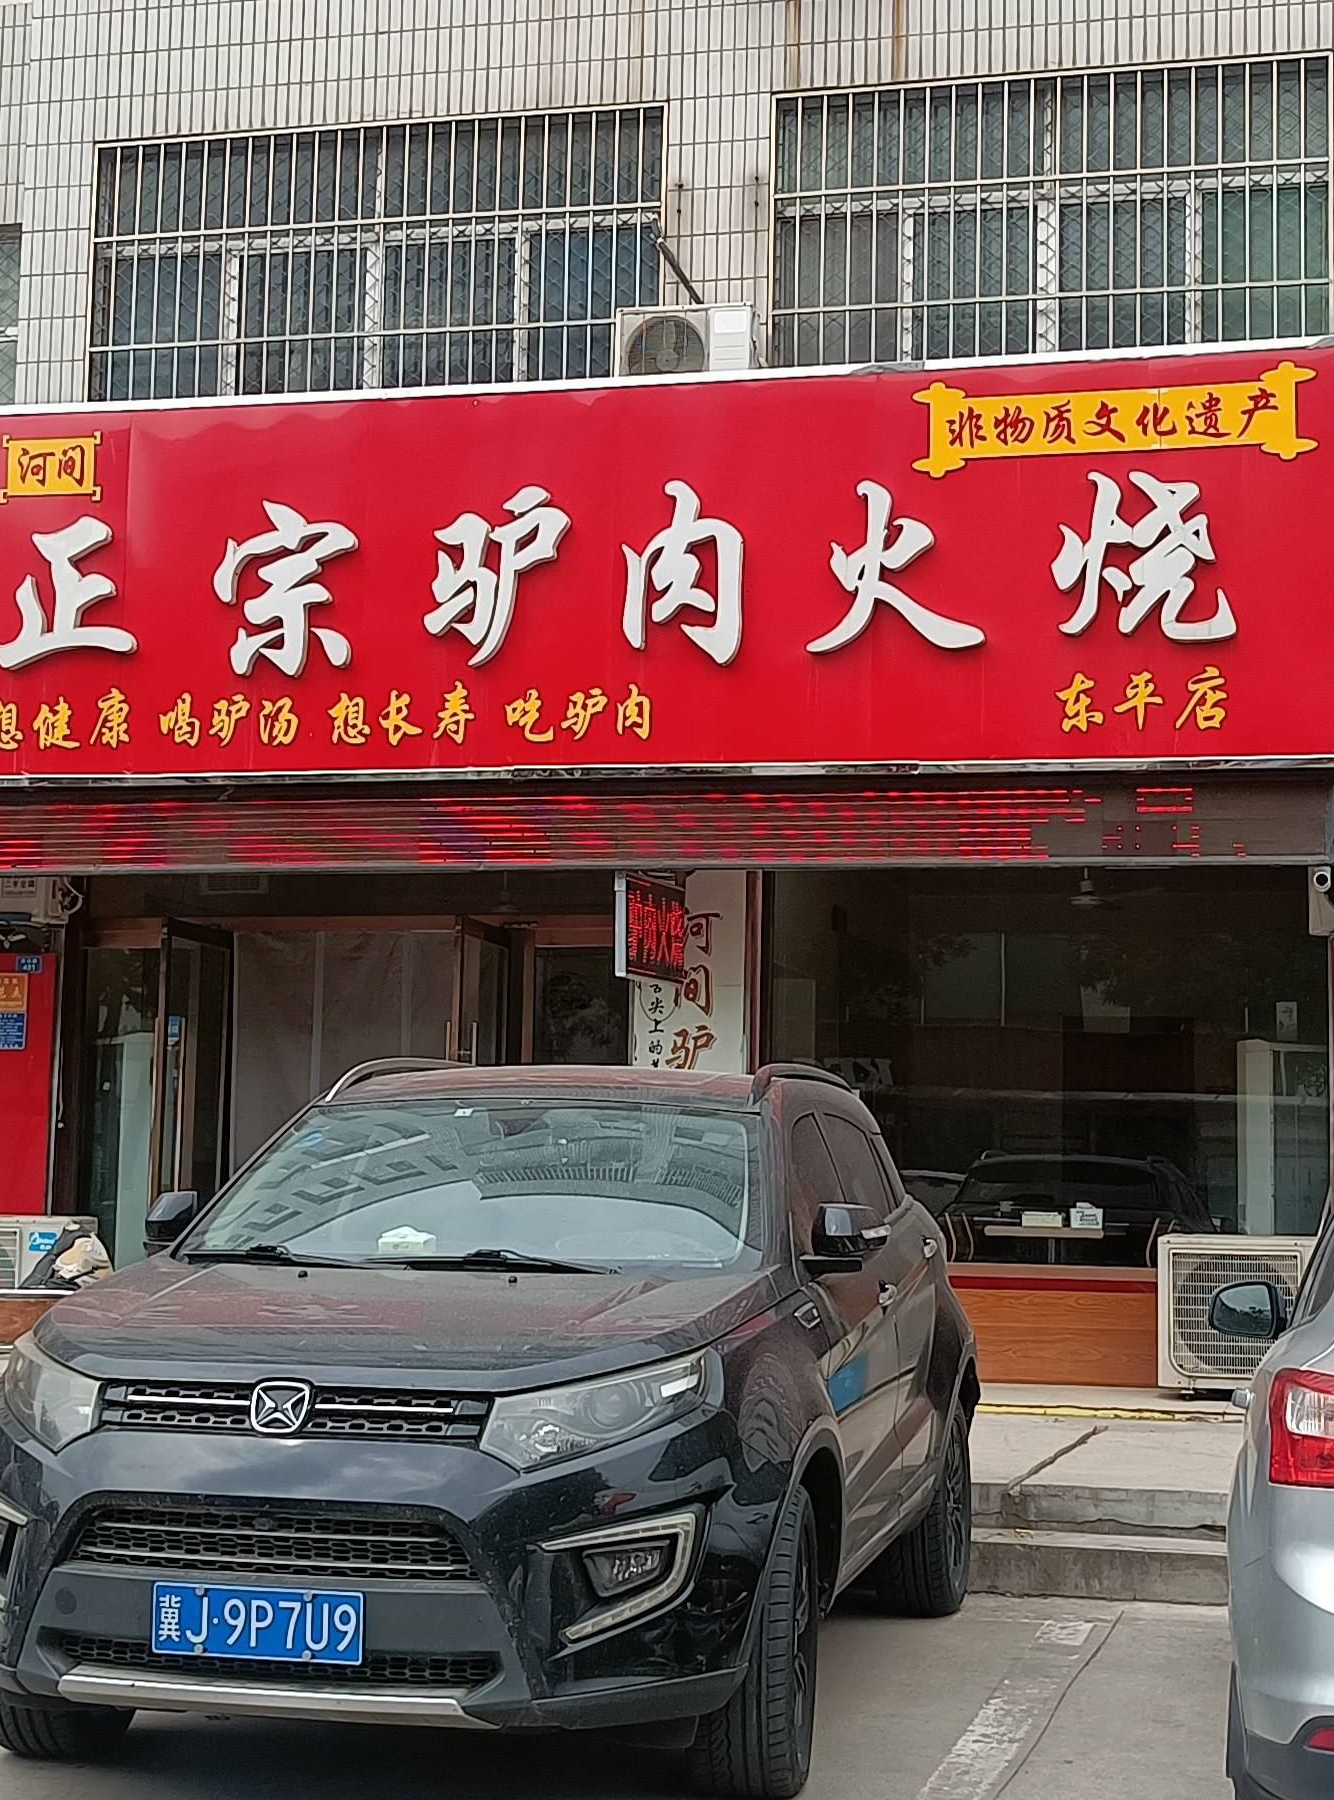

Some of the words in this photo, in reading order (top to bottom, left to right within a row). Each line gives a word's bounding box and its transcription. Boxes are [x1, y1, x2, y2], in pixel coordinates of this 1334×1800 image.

[945, 387, 1281, 448] 非物质文化遗产
[16, 445, 86, 487] 河间
[158, 695, 299, 749] 喝驴汤
[330, 680, 476, 748] 想长寿
[504, 685, 652, 744] 吃驴肉
[1055, 665, 1230, 734] 东平店
